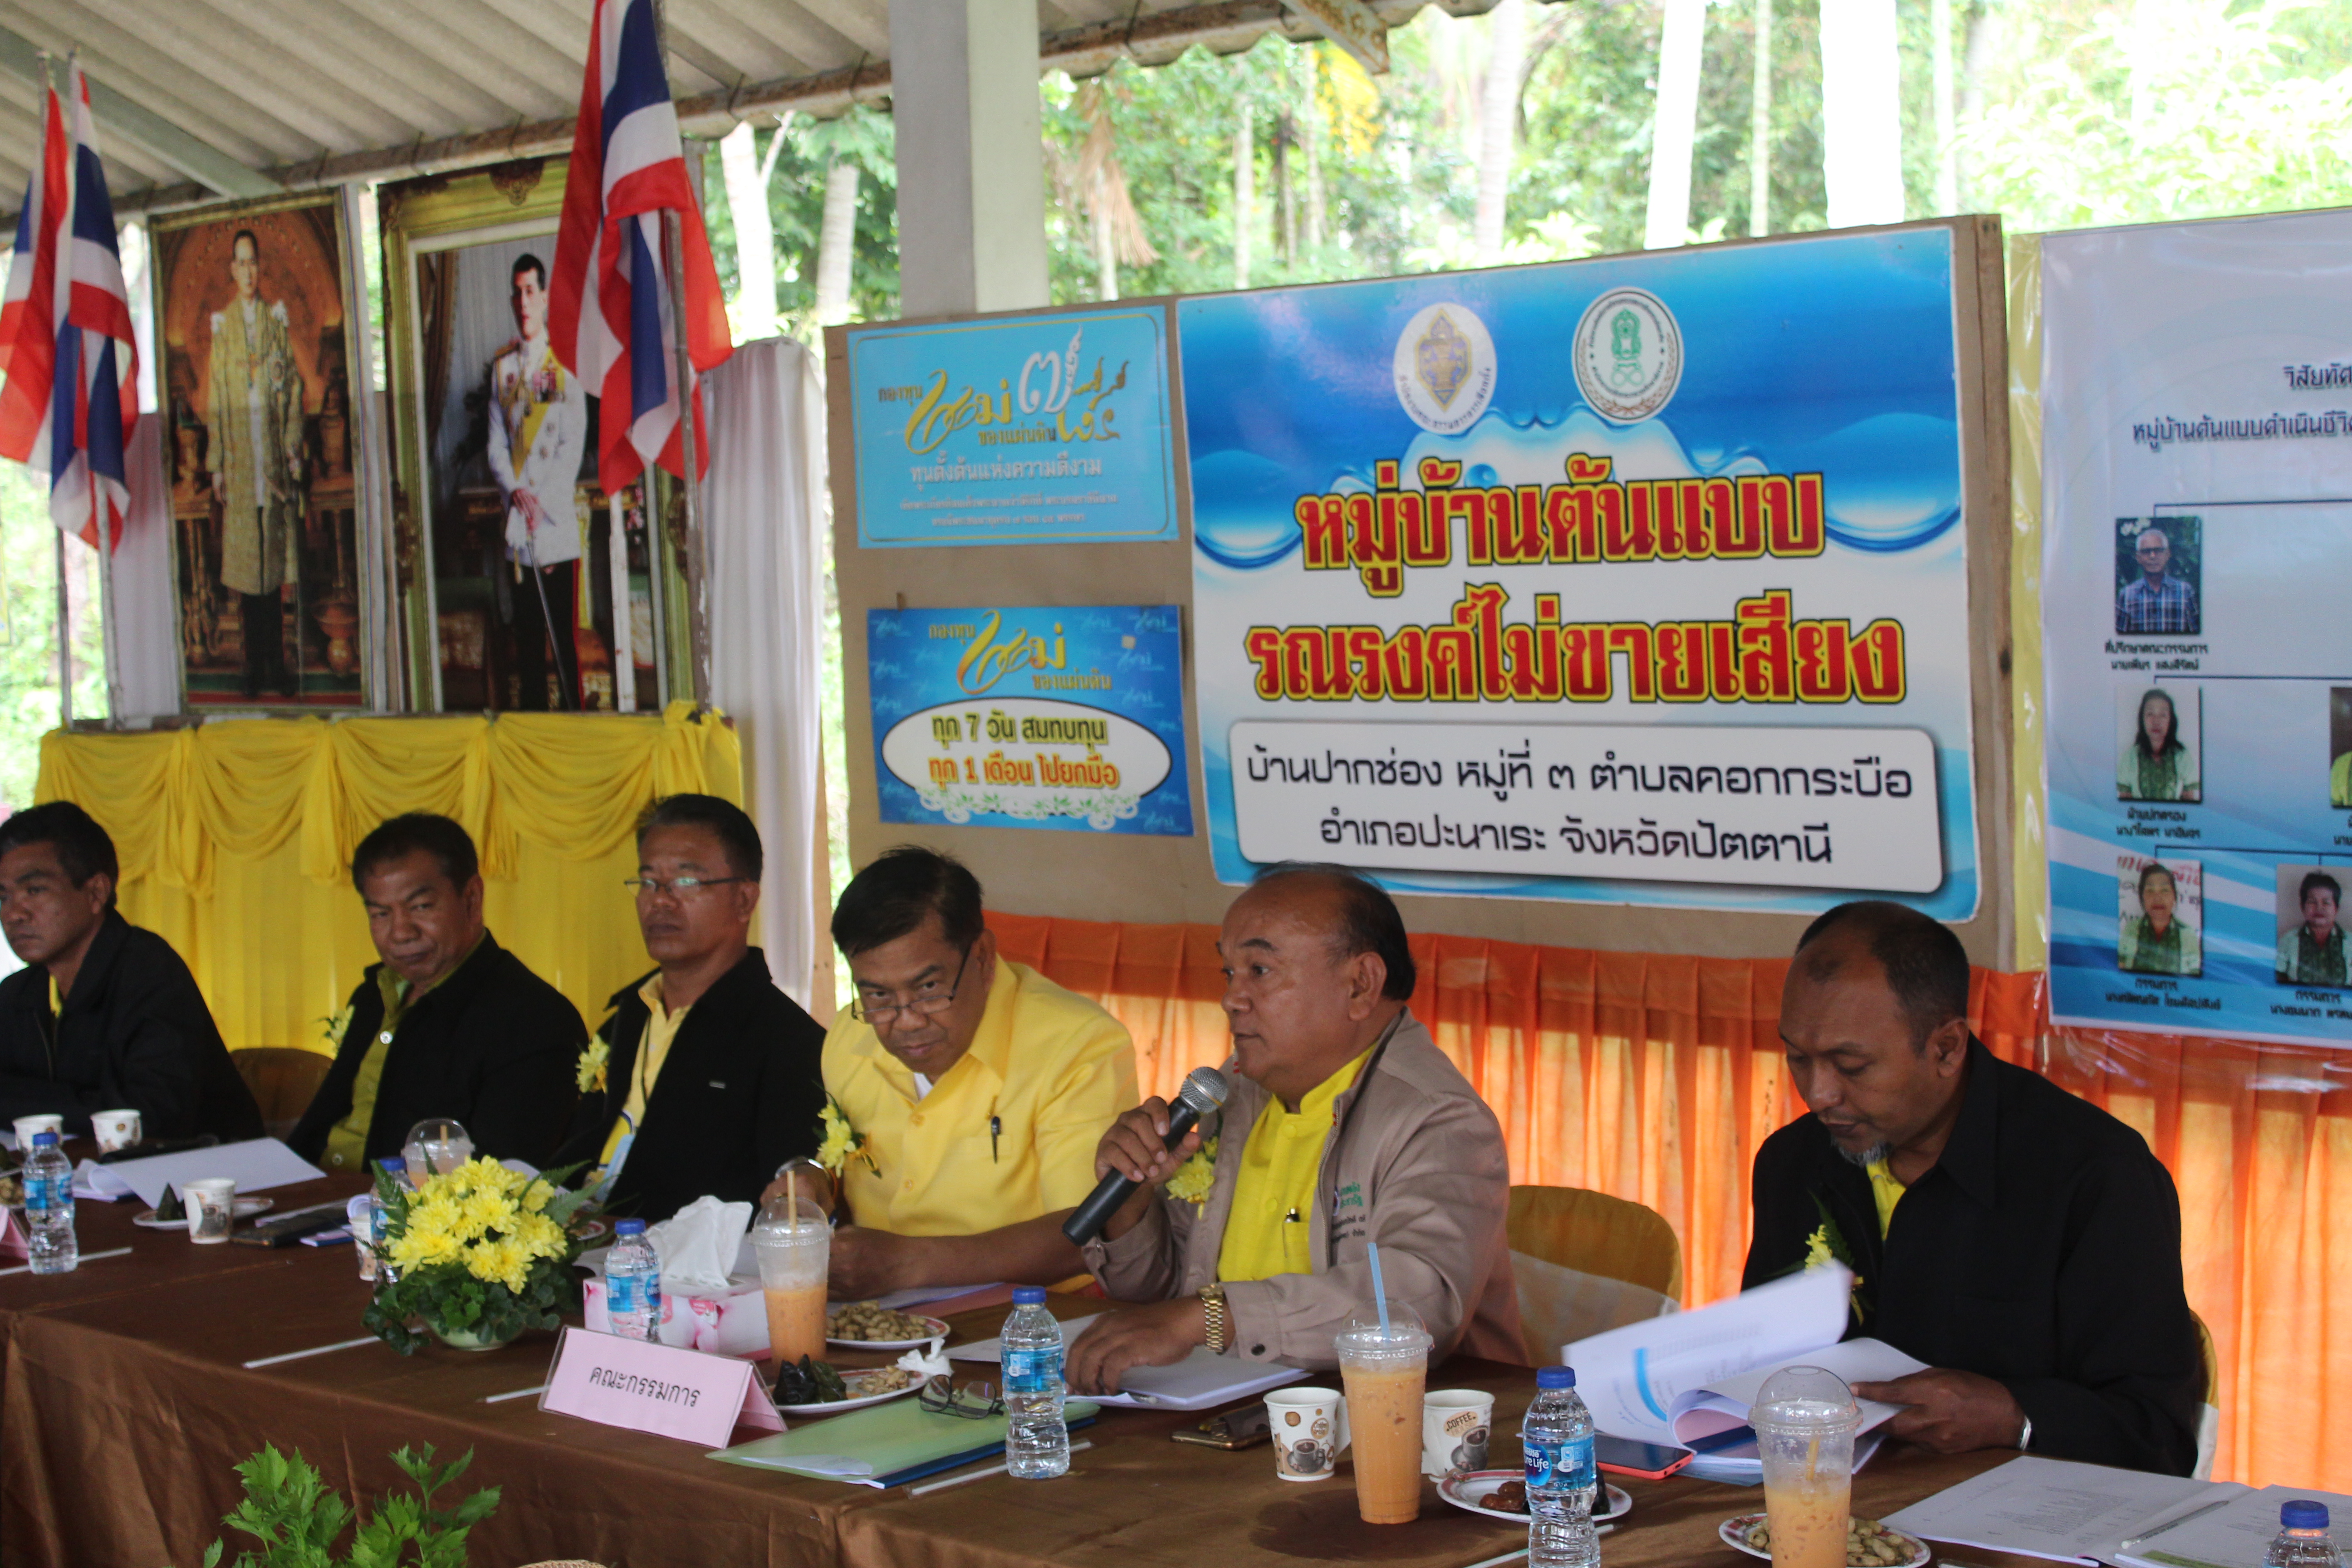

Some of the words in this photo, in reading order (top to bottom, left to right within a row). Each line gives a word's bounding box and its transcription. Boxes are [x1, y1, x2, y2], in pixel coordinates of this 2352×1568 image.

[878, 384, 923, 407] กองทุน
[977, 420, 1057, 446] ของแผ่นดิน
[1294, 453, 1825, 598] หมู่บ้านต้นแบบ
[929, 624, 976, 646] กองทุน
[1032, 666, 1112, 690] ของแผ่นดิน
[1244, 583, 1906, 705] รณรงค์ไม่ขายเสียง
[931, 714, 961, 750] ทุก
[965, 711, 980, 742] 7
[986, 708, 1018, 743] วัน
[1021, 715, 1108, 754] สมทบทุน
[928, 756, 959, 792] ทุก
[963, 755, 979, 784] 1
[983, 750, 1035, 787] เดือน
[1035, 751, 1120, 790] ไปยกมือ
[1248, 744, 1442, 785] บ้านปากช่อง
[1457, 739, 1533, 802] หมู่ที่
[1548, 764, 1575, 790] ๓
[1590, 750, 1912, 799] ตำบลคอกกระบือ
[1320, 806, 1546, 851] อำเภอปะนาเระ
[1559, 815, 1833, 864] จังหวัดปัตตานี
[589, 1366, 701, 1407] คณะกรรมการ
[1446, 1411, 1472, 1430] COFFEE
[1533, 1458, 1549, 1472] Life
